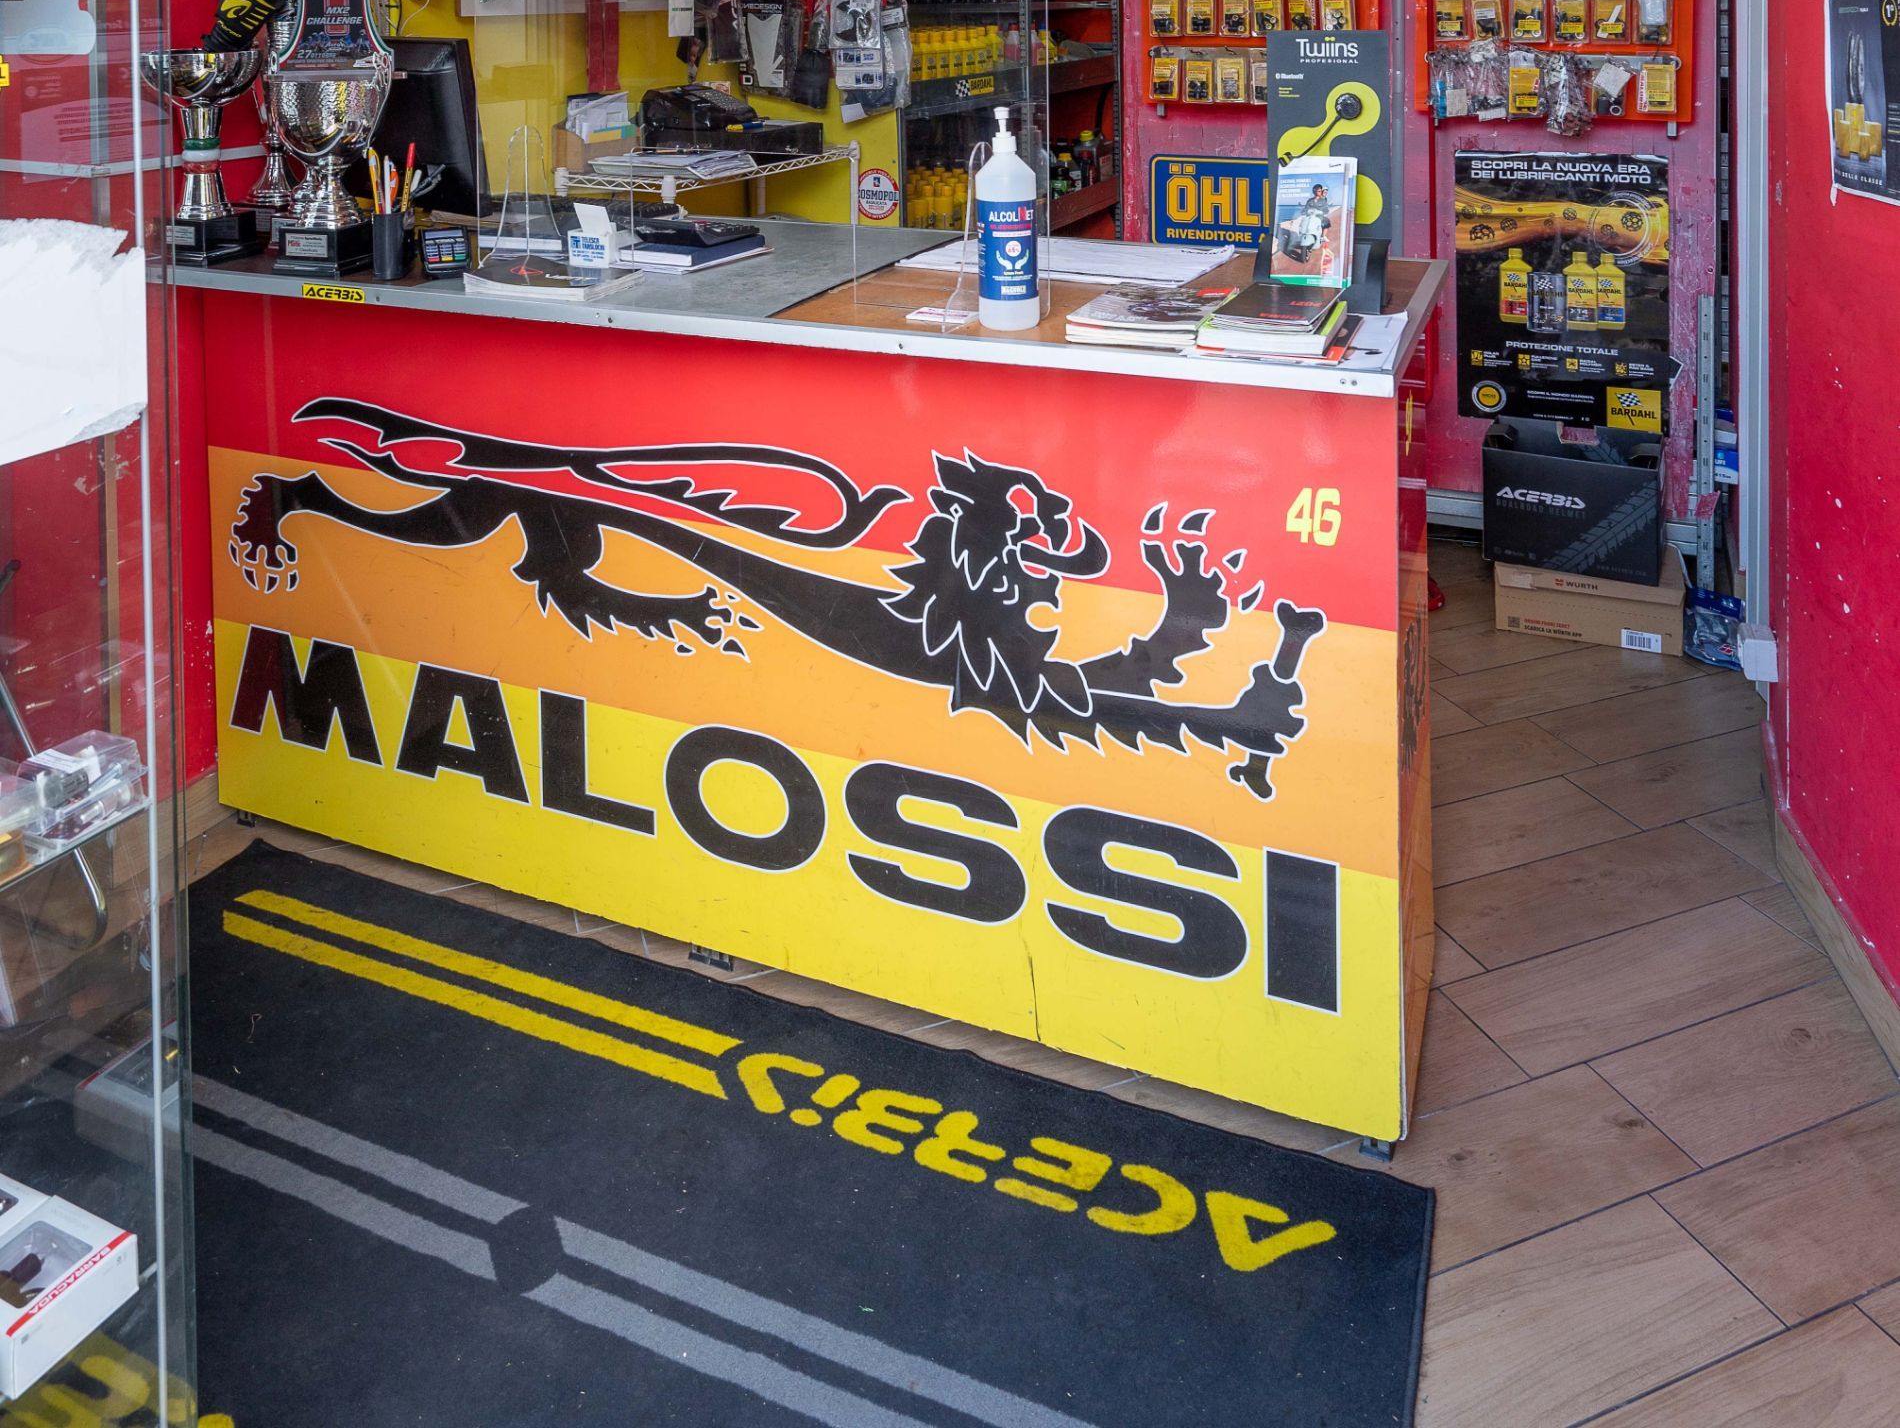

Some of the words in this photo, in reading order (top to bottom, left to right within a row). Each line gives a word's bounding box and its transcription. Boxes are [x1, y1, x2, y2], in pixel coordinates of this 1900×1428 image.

[325, 6, 351, 14] MX2
[306, 16, 364, 25] CHALLENGE
[297, 49, 313, 59] 27
[1295, 36, 1359, 58] Twiins
[970, 78, 993, 90] BARDAHL
[1470, 160, 1528, 170] SCOPRI
[1532, 161, 1552, 171] LA
[1556, 162, 1613, 173] NUOVA
[1617, 164, 1651, 174] ERA
[1470, 170, 1495, 179] DEI
[1499, 171, 1600, 183] LUBRIFICANTI
[1604, 174, 1651, 184] MOTO
[858, 188, 899, 202] OSMOPOL
[1166, 162, 1270, 227] ÖHL
[1166, 228, 1252, 243] RIVENDITORE
[305, 285, 363, 302] ACERBIS
[1568, 287, 1595, 295] BARDAHL
[1505, 340, 1574, 352] PROTEZIONE
[1576, 346, 1619, 356] TOTALE
[1610, 407, 1658, 420] BARDAHL
[1496, 486, 1587, 509] ACERBIS
[1286, 488, 1342, 546] 46
[228, 623, 1341, 1017] MALOSSI
[28, 1245, 112, 1316] BARRACUDA
